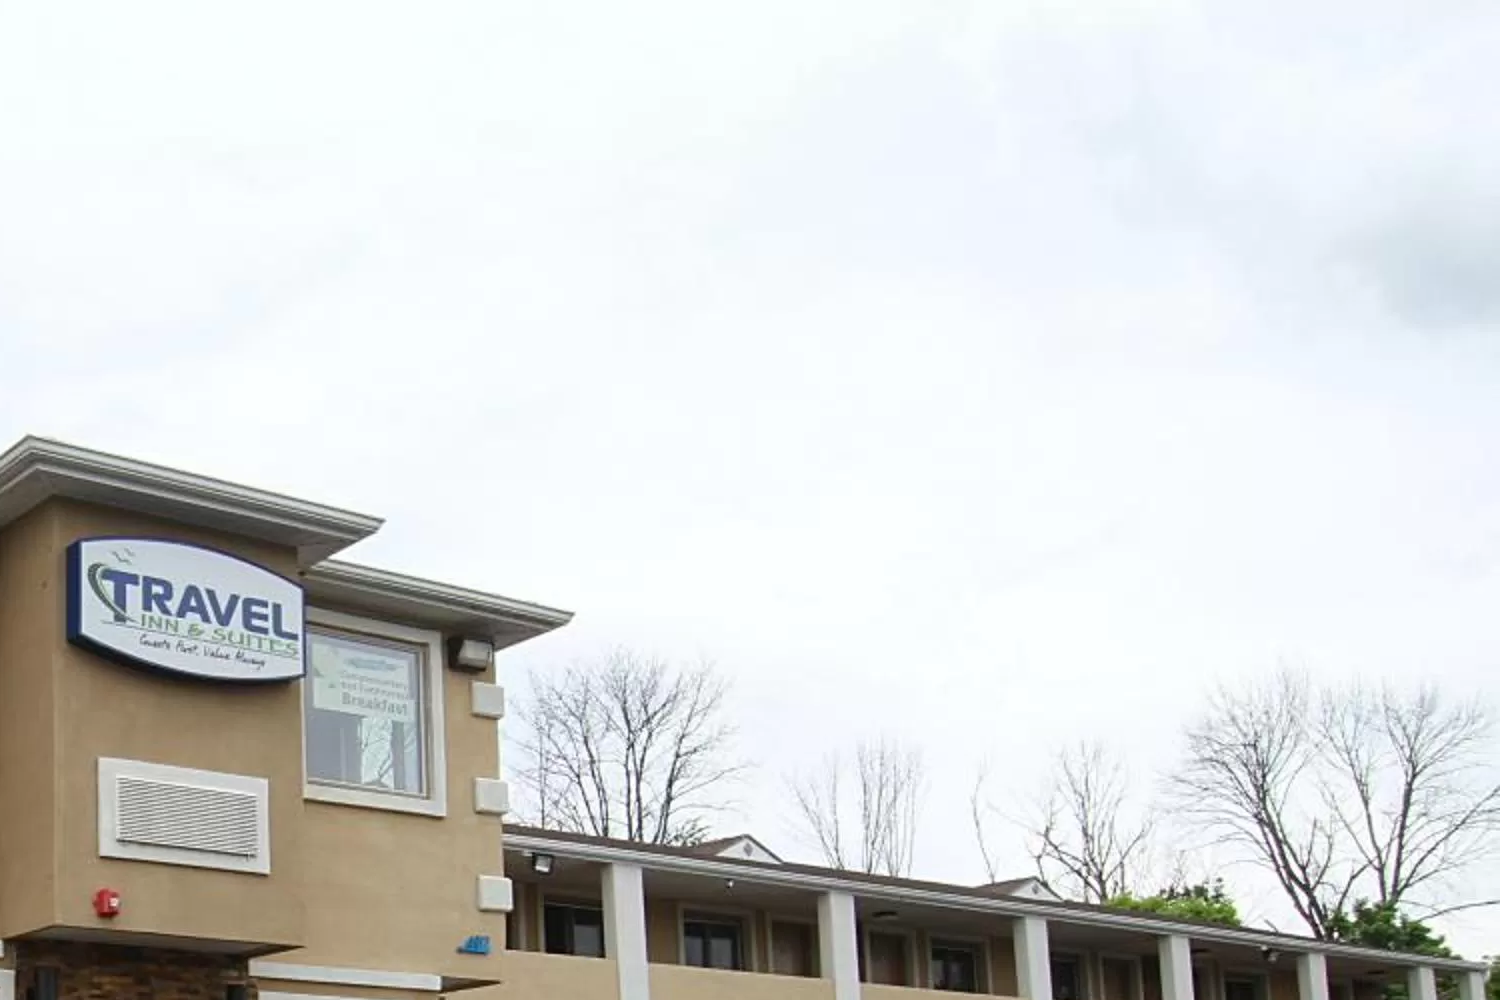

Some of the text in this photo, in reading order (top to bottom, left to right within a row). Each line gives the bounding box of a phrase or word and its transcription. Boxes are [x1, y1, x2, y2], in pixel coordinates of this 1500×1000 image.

[102, 568, 299, 640] TRAVEL
[140, 613, 299, 657] INN & SUITES
